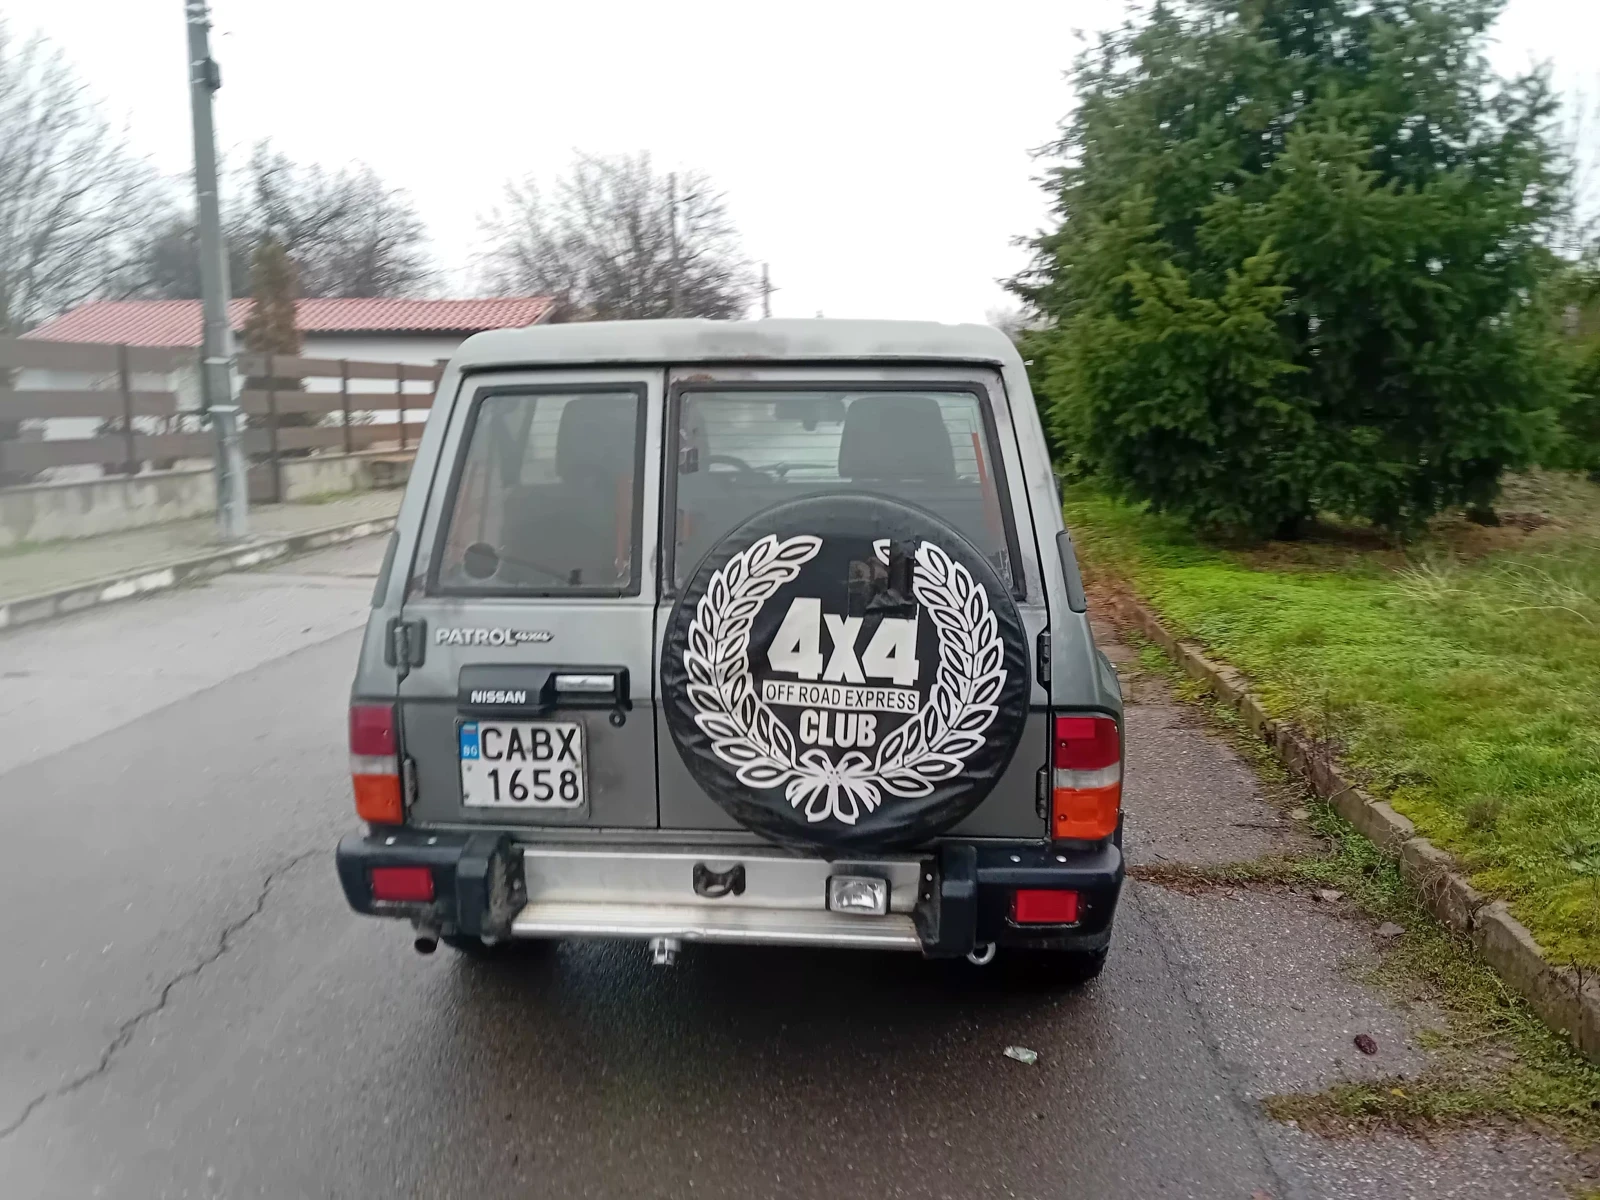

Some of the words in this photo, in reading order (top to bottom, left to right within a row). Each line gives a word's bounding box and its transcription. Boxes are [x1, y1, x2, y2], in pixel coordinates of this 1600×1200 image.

[435, 628, 518, 646] PATROL
[471, 690, 526, 704] NISSAN
[766, 683, 795, 701] OFF
[799, 686, 841, 705] ROAD
[845, 689, 916, 711] EXPRESS
[799, 709, 877, 748] CLUB
[480, 727, 577, 762] CABX
[487, 768, 579, 801] 1658
